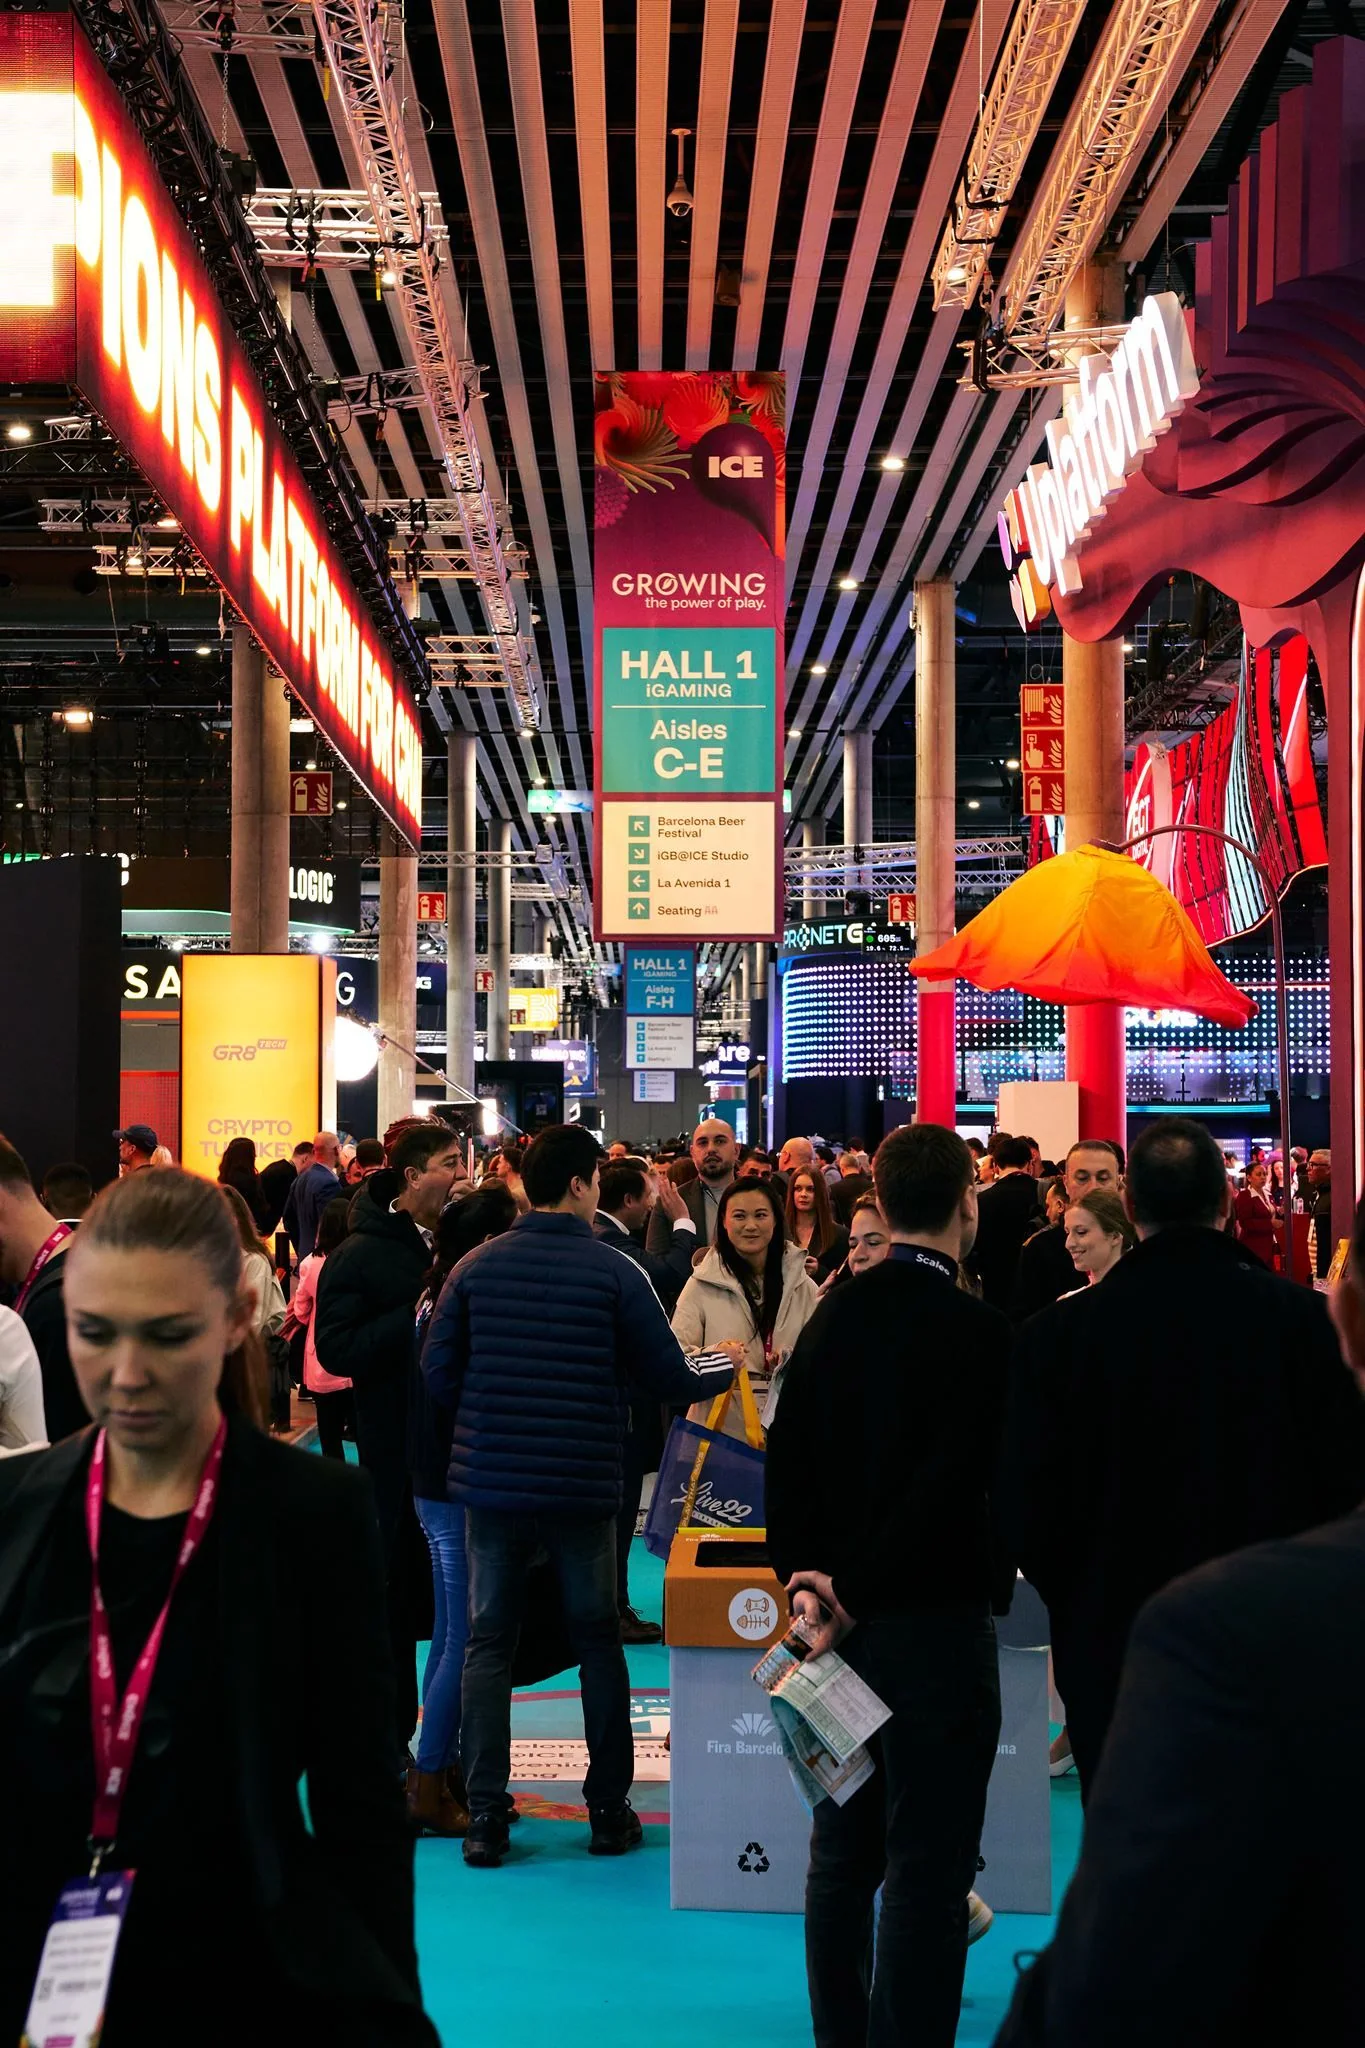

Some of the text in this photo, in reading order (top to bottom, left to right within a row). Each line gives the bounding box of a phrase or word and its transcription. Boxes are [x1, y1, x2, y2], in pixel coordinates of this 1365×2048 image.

[708, 455, 763, 478] ICE
[231, 383, 360, 738] PLATFORM
[360, 640, 393, 785] FOR
[612, 572, 767, 596] GROWING
[645, 597, 767, 611] the power of play.
[621, 650, 758, 680] HALL 1
[646, 683, 732, 698] iGAMING
[650, 719, 728, 740] Aisles
[653, 747, 724, 779] C-E
[657, 816, 746, 826] Barcelona Beer
[657, 828, 702, 838] Festival
[657, 851, 749, 862] iGB@ICE Studio
[657, 879, 731, 888] La Avenida 1
[657, 906, 702, 917] Seating
[633, 958, 687, 971] HALL 1
[645, 985, 676, 994] Aisles
[646, 995, 674, 1009] F-H
[259, 1040, 286, 1048] TECH
[213, 1045, 257, 1061] GR8
[207, 1118, 293, 1136] CRYPTO
[670, 1481, 753, 1523] Live22
[707, 1740, 732, 1754] Fira
[735, 1740, 784, 1755] Barcelo
